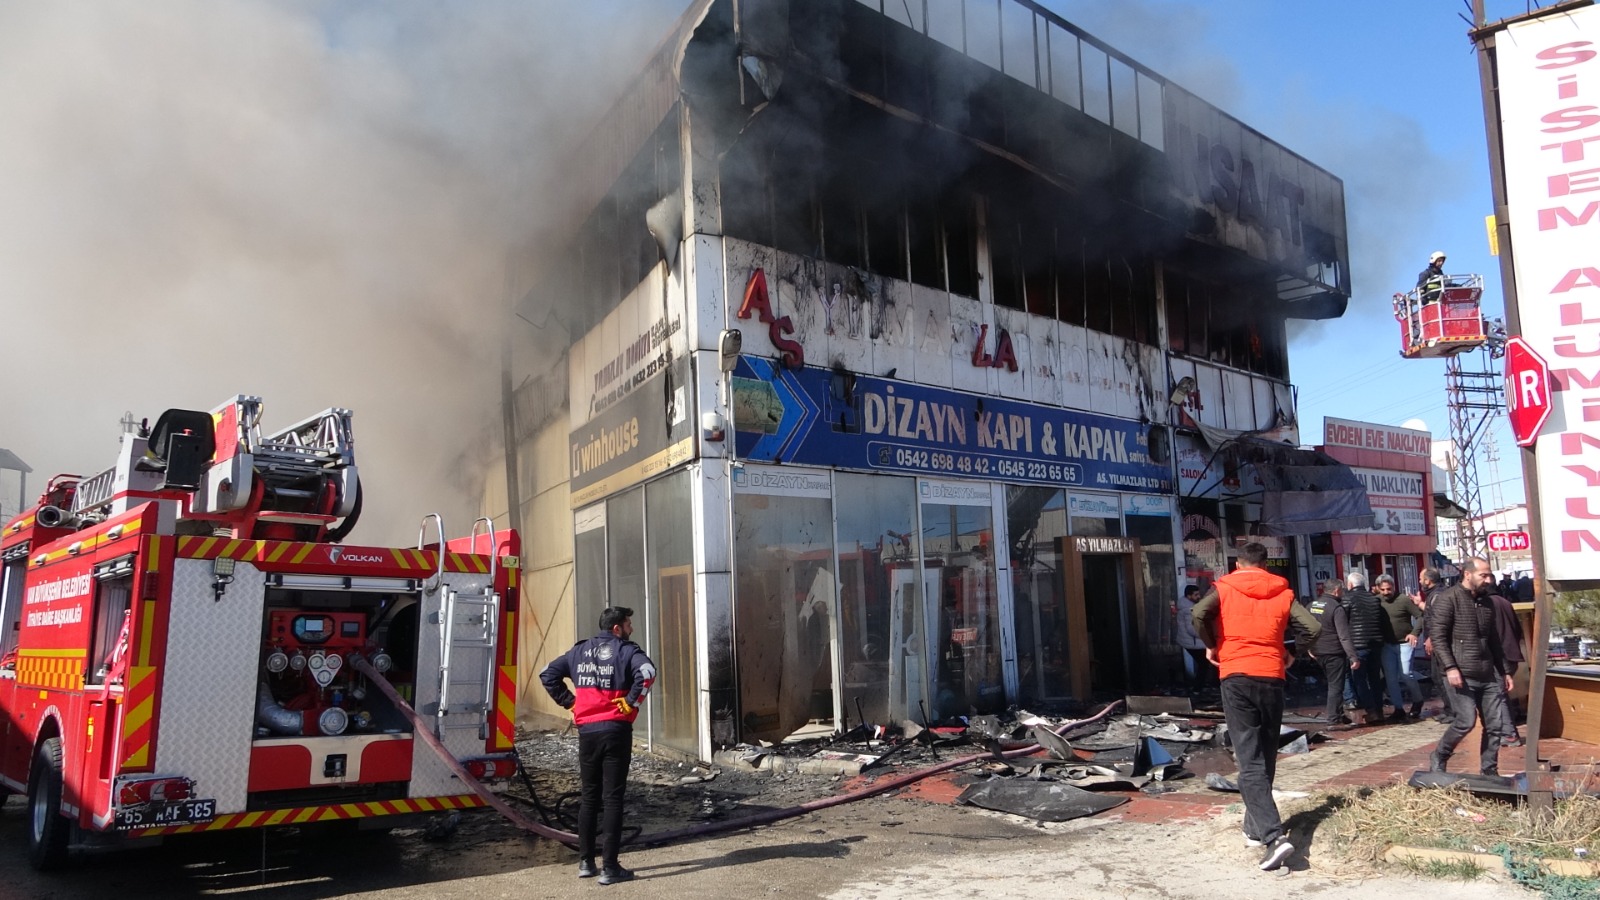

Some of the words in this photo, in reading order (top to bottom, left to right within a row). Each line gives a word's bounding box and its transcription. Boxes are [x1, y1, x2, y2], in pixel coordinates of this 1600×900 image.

[1535, 41, 1600, 231] SİSTEM
[1506, 369, 1542, 413] DUR
[864, 385, 967, 445] DİZAYN
[977, 411, 1033, 453] KAPI
[1041, 421, 1058, 456] &
[1063, 422, 1129, 464] KAPAK
[581, 417, 639, 473] winhouse
[1326, 423, 1362, 446] EVDEN
[1366, 428, 1384, 449] EVE
[1387, 431, 1432, 455] NAKLİYAT
[896, 449, 929, 468] 0542
[931, 454, 954, 471] 698
[957, 456, 972, 472] 48
[974, 458, 989, 474] 42
[998, 460, 1025, 478] 0545
[1028, 463, 1047, 479] 223
[1049, 466, 1062, 480] 65
[1064, 467, 1076, 481] 65
[751, 471, 808, 490] DİZAYN
[932, 484, 974, 498] DİZAYN
[1109, 474, 1147, 487] YILMAZLAR
[1147, 478, 1160, 489] LTD
[1371, 473, 1422, 495] NAKLİYAT
[1076, 538, 1087, 552] AS
[1088, 538, 1135, 553] YILMAZLAR
[1493, 533, 1526, 548] BİM
[342, 554, 383, 563] VOLKAN
[35, 576, 62, 606] BÜYÜKŞEHİR
[62, 568, 92, 598] BELEDİYESİ
[578, 675, 611, 688] İTFAİYE
